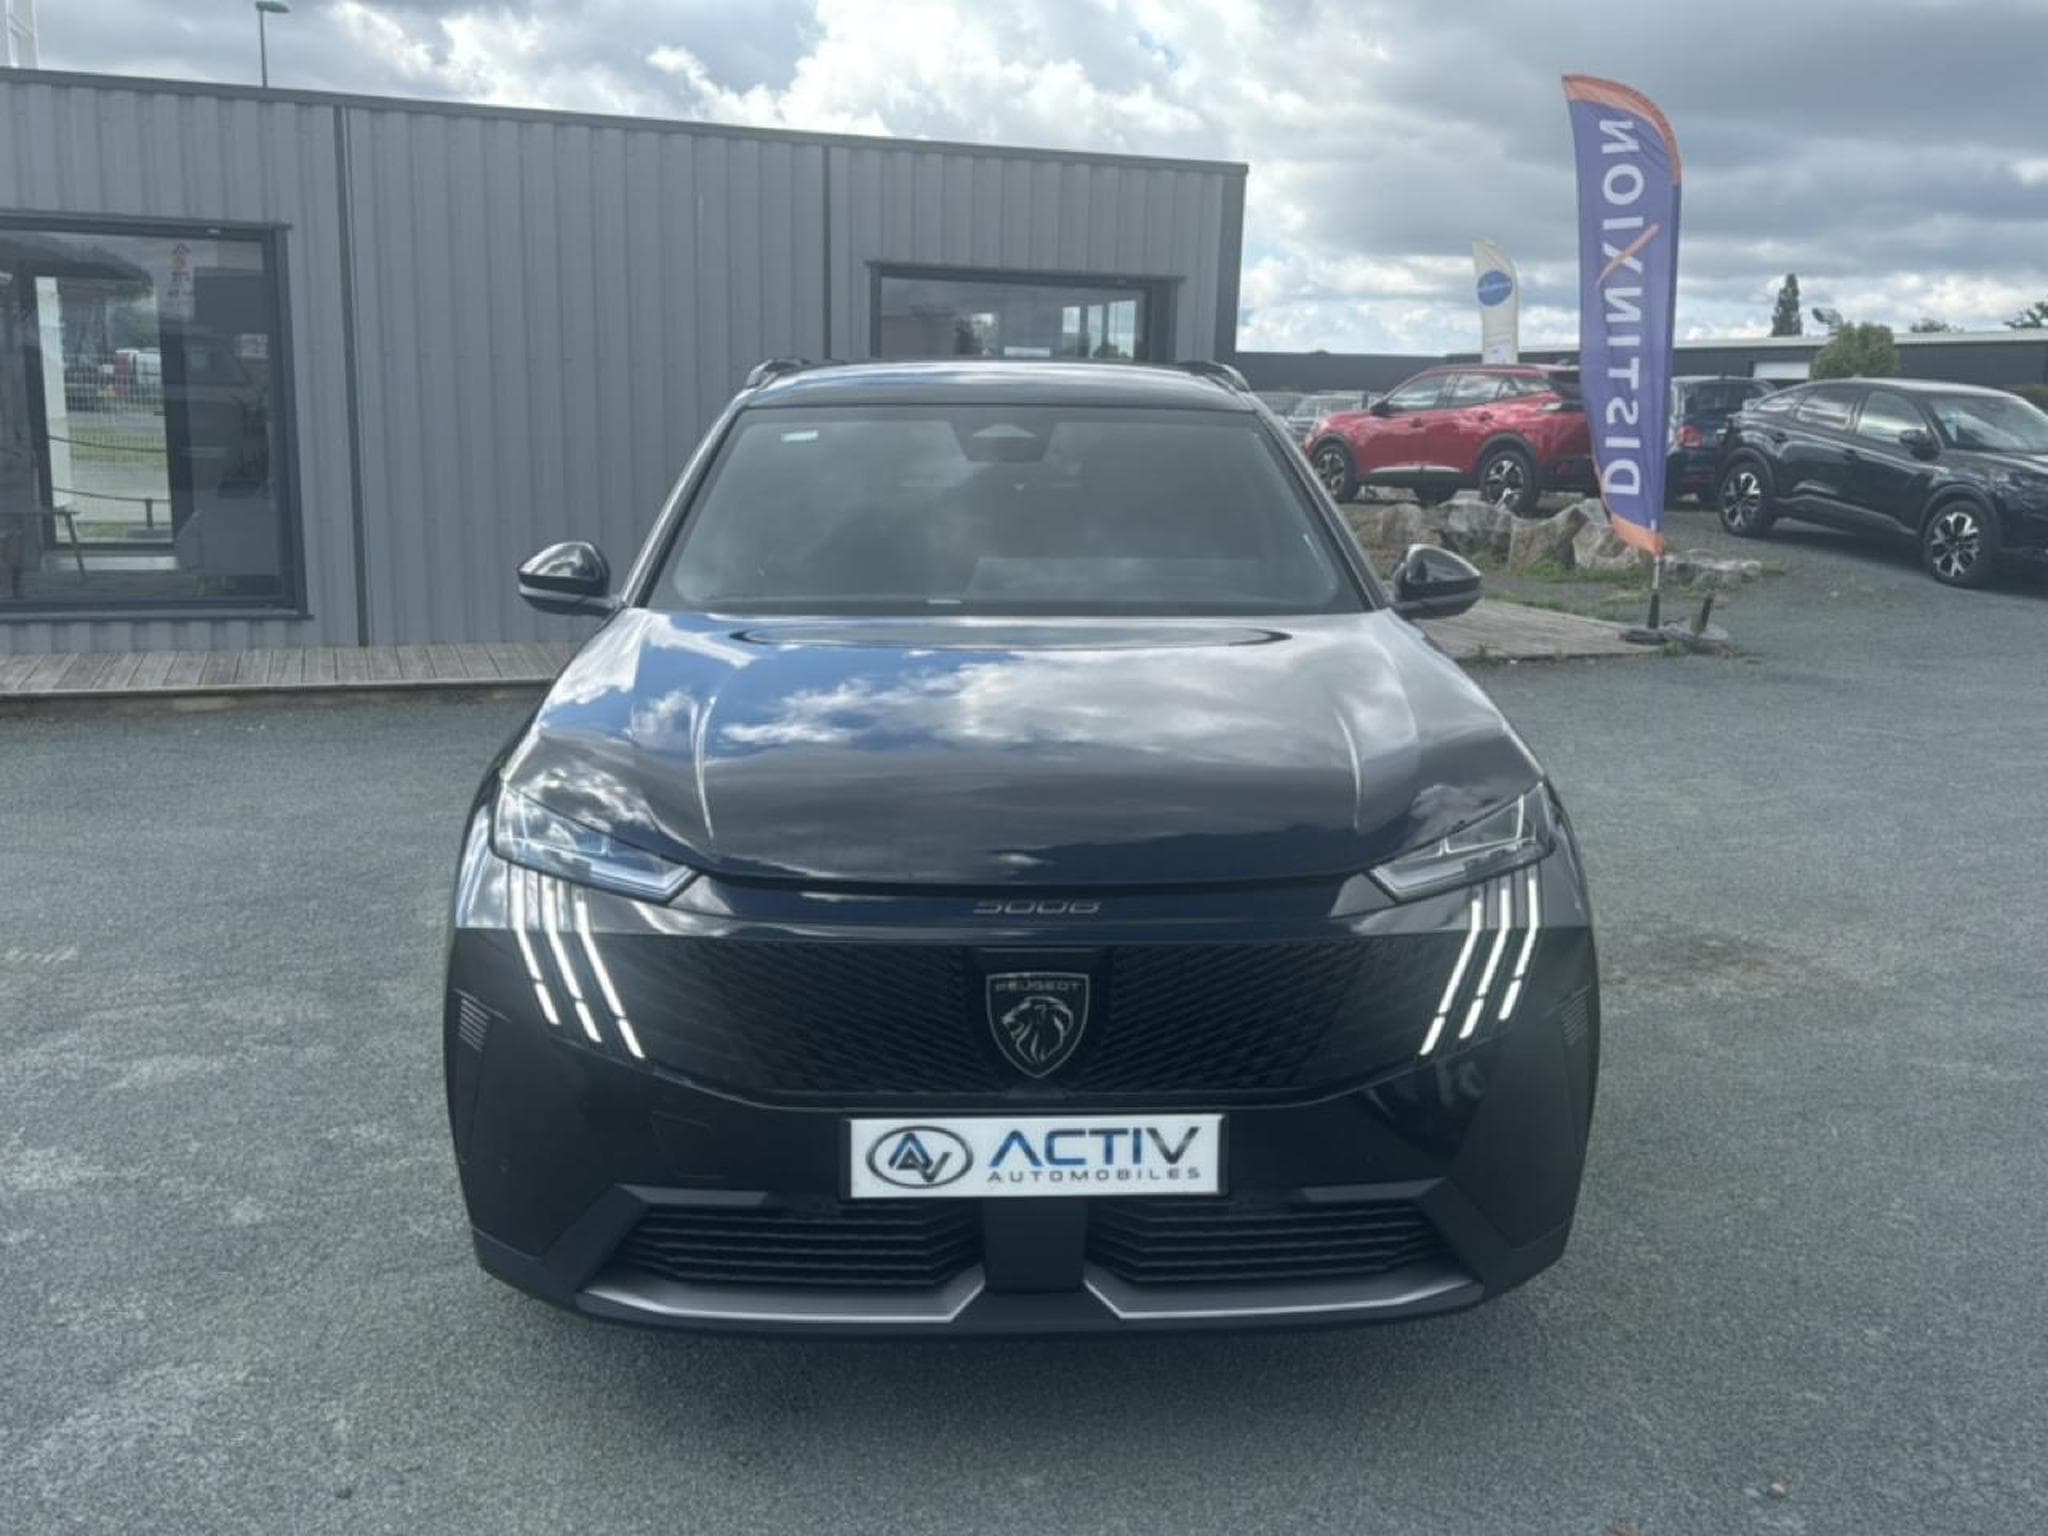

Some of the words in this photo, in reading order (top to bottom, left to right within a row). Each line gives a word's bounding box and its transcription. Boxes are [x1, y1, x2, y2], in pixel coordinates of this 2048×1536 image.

[995, 980, 1082, 992] PEUGEOT
[988, 1126, 1200, 1167] ACTIV
[987, 1167, 1201, 1184] AUTOMOBILES
